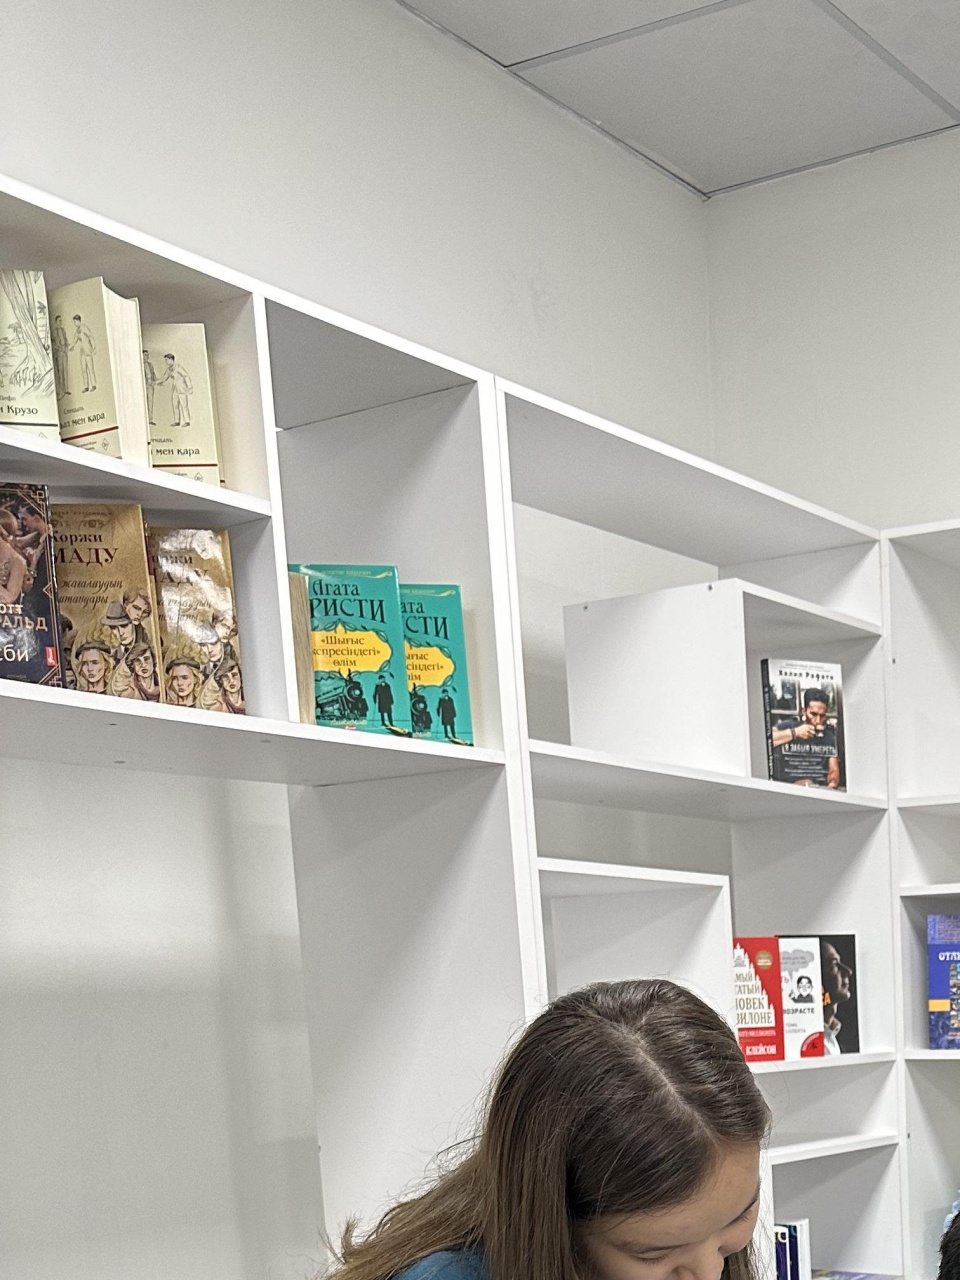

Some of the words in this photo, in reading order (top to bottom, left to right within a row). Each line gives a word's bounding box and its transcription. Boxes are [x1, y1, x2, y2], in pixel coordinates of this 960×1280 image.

[7, 404, 38, 416] Крузо
[156, 448, 174, 456] мен
[312, 578, 360, 596] Агата
[402, 616, 450, 641] СТИ
[332, 658, 357, 668] өлім
[735, 971, 752, 982] МЫЙ
